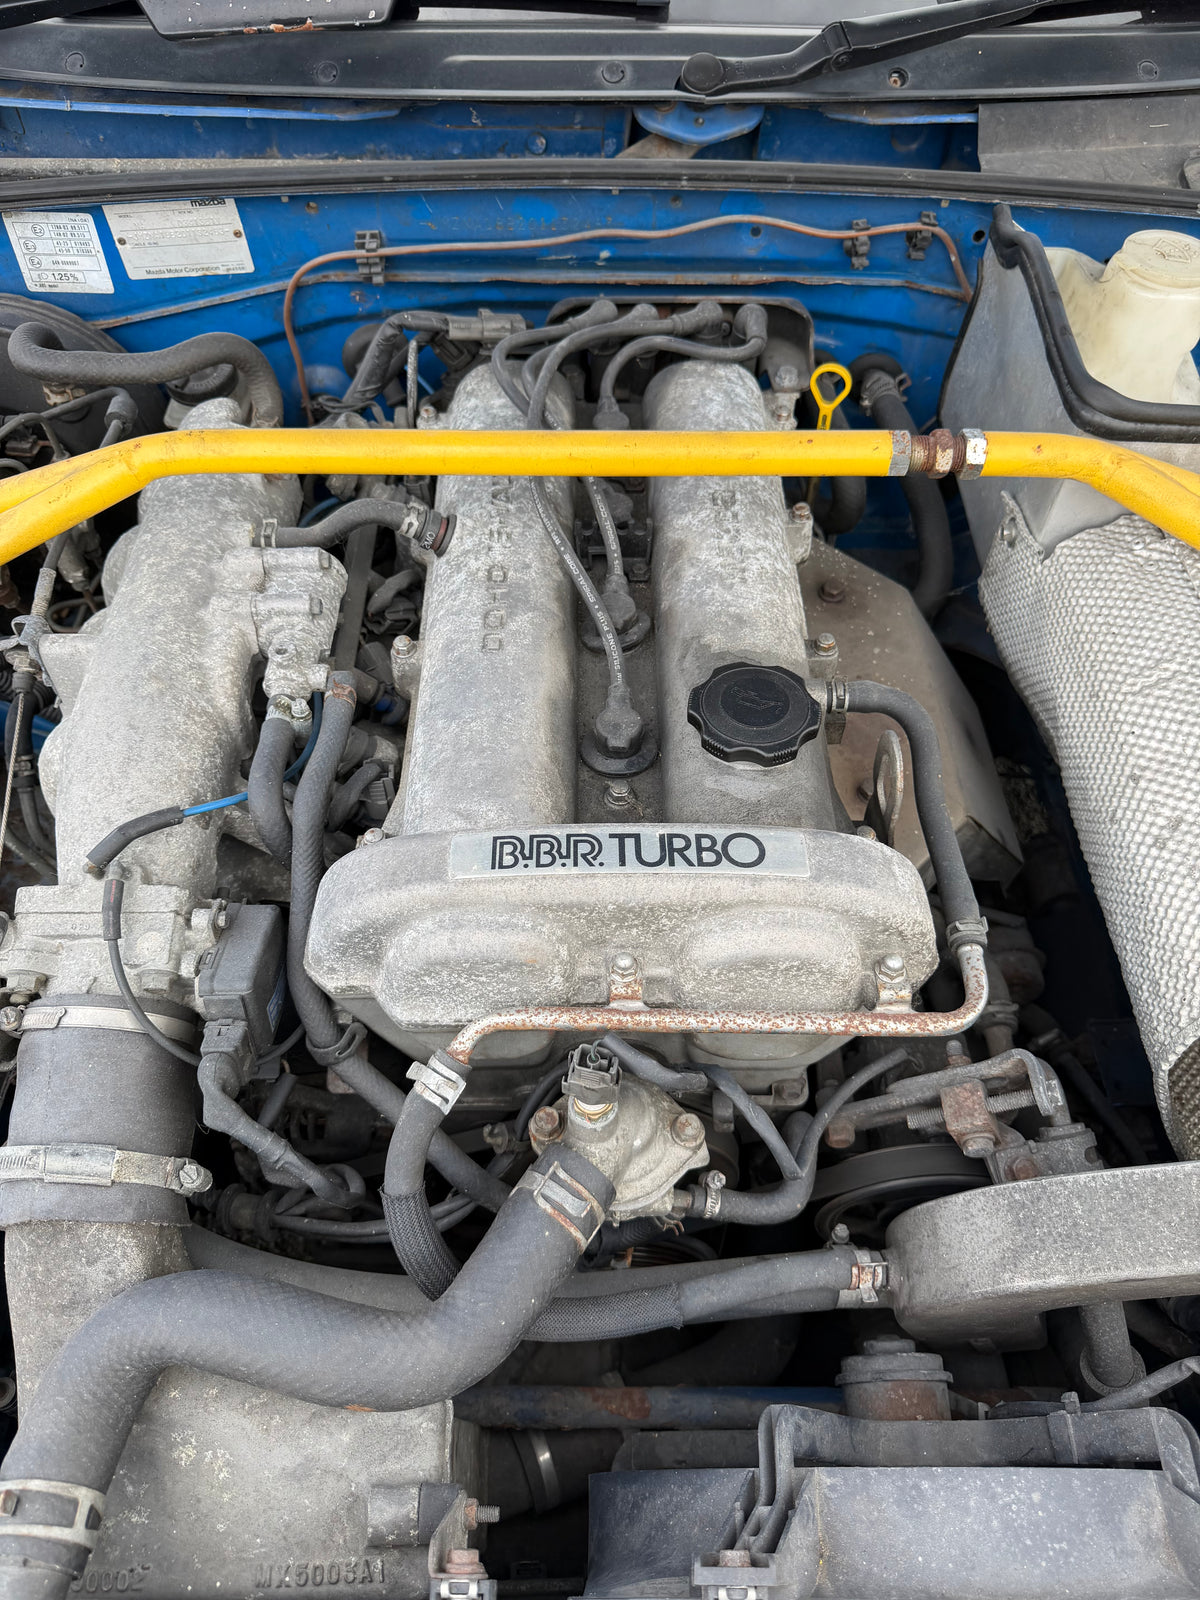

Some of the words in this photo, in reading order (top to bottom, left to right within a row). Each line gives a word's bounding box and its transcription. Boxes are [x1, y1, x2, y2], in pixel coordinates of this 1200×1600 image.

[51, 272, 79, 281] 1.25%
[145, 268, 166, 276] Mazda
[166, 266, 184, 274] Motor
[184, 265, 221, 274] Corporation
[563, 552, 580, 575] CORE
[577, 574, 596, 603] SPIRAL
[596, 610, 611, 632] PLUS
[606, 632, 621, 670] SILICONE
[609, 832, 766, 868] TURBO
